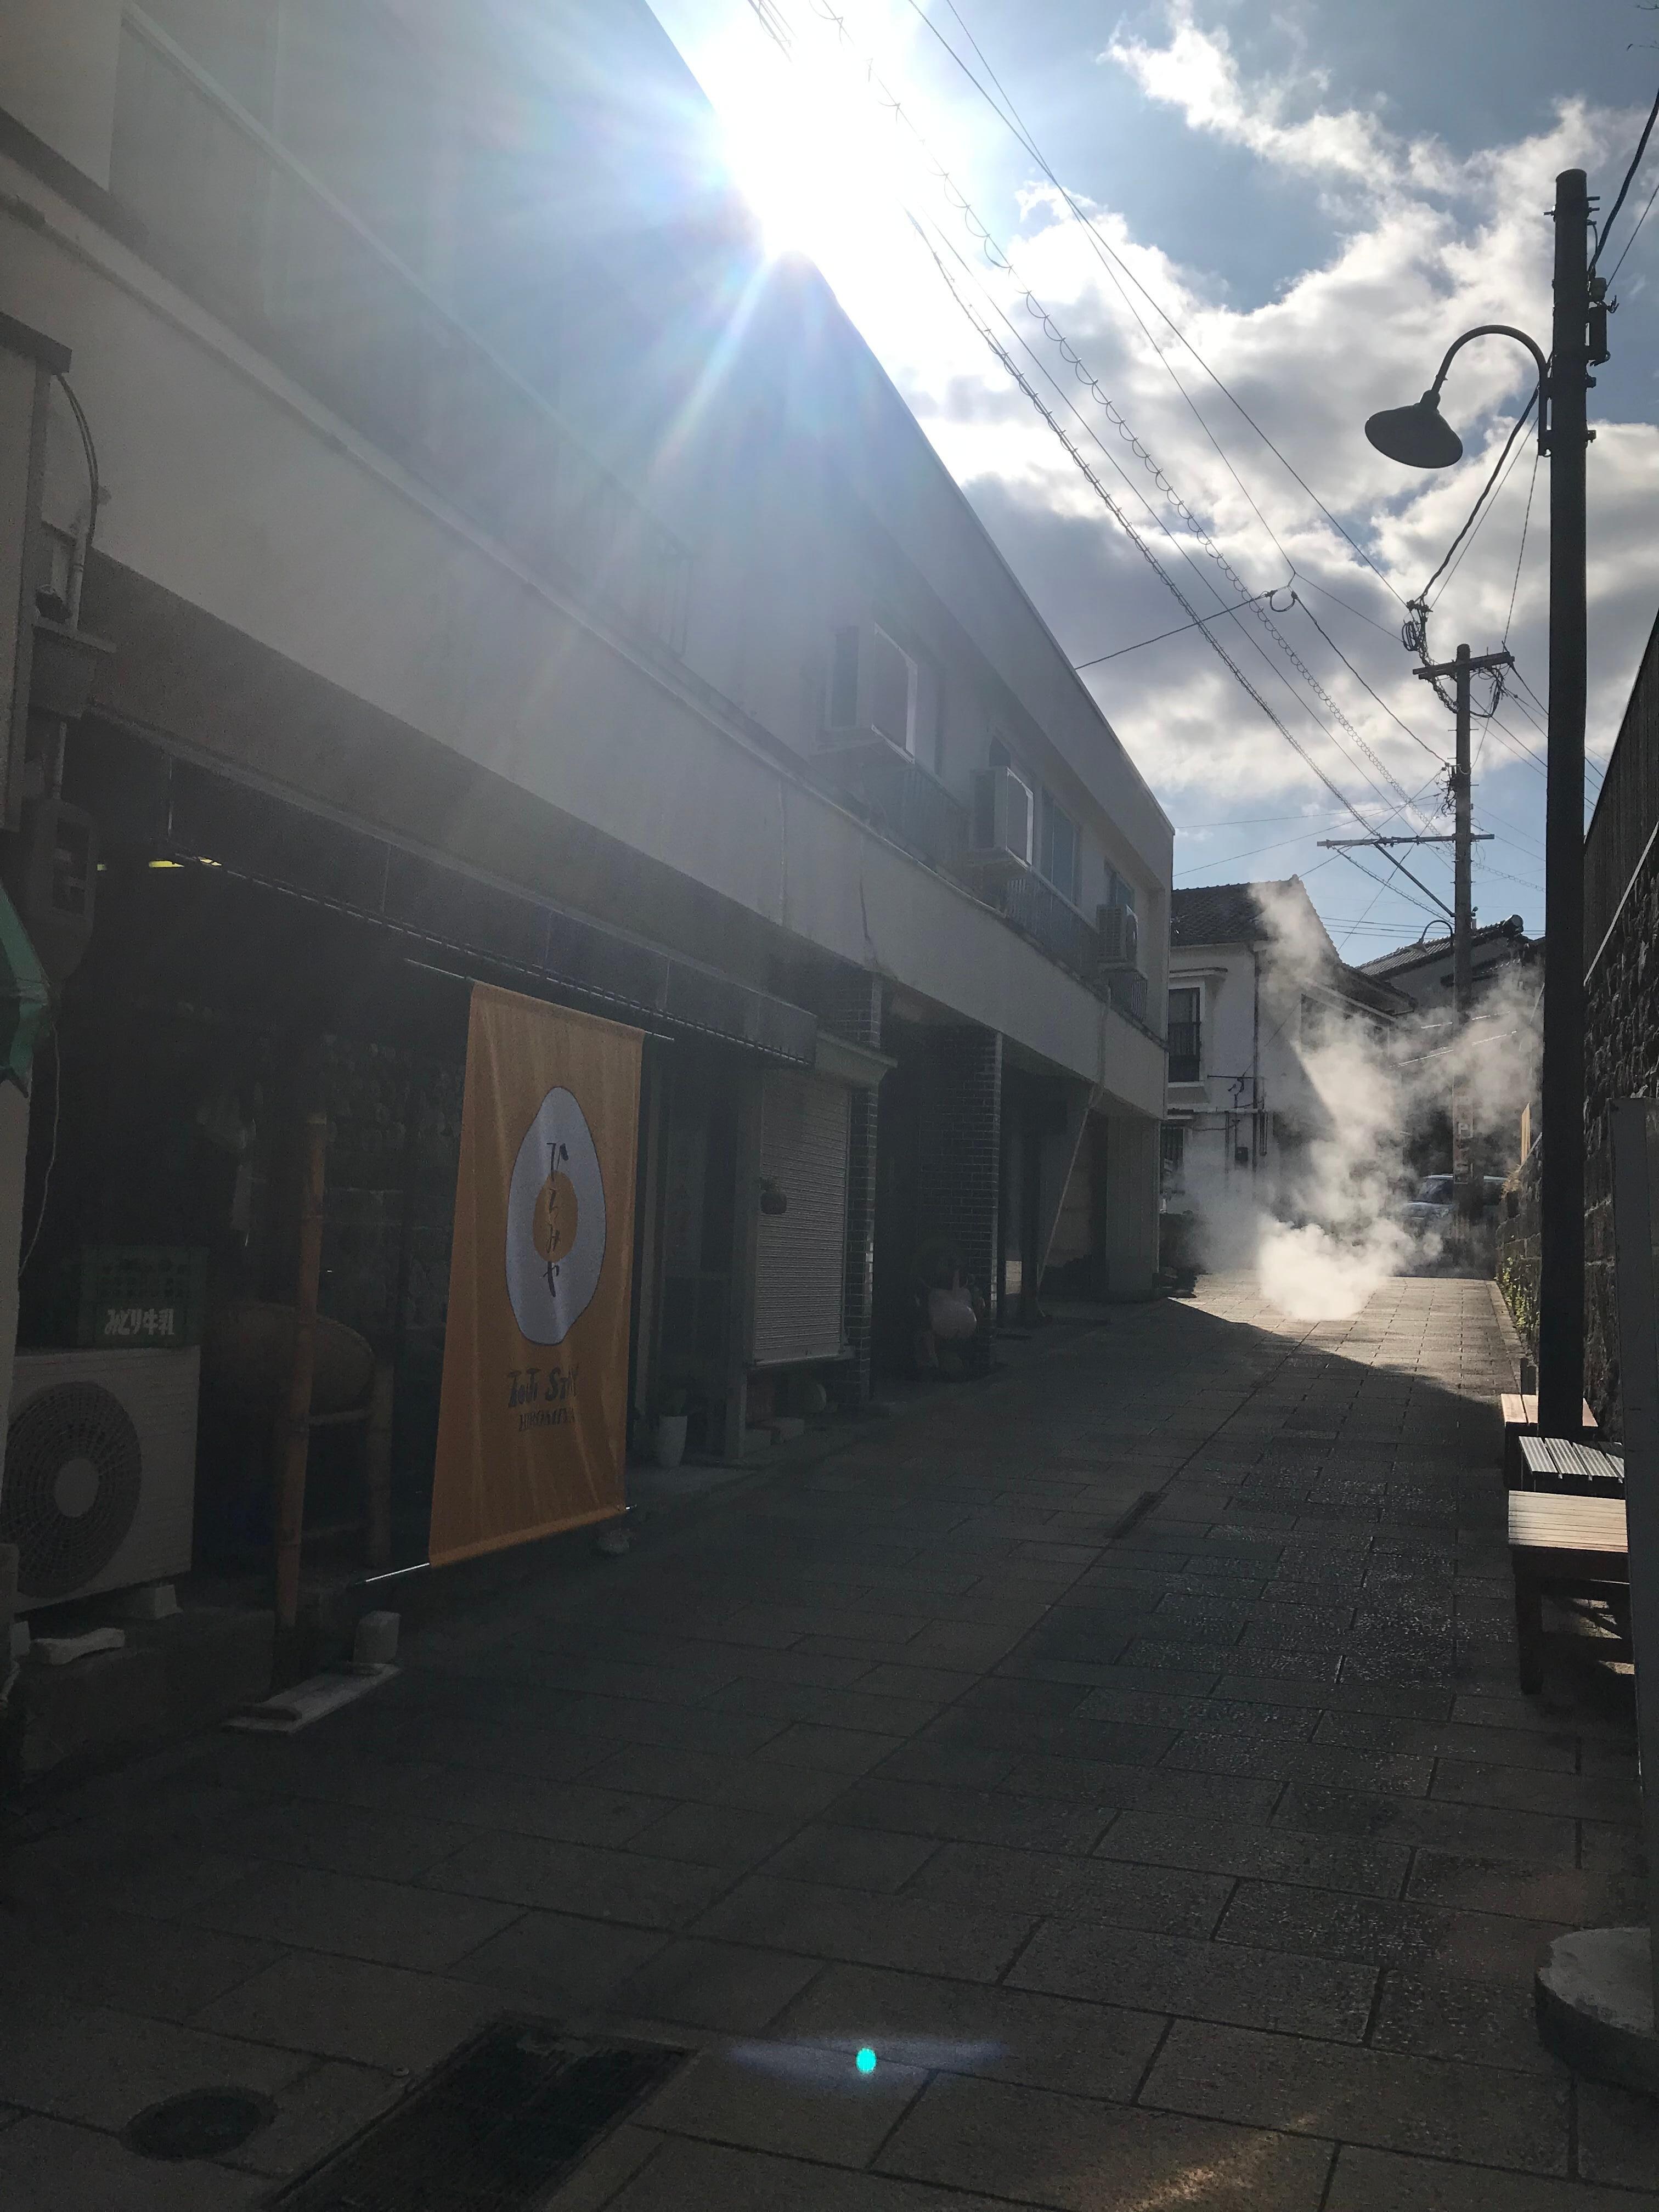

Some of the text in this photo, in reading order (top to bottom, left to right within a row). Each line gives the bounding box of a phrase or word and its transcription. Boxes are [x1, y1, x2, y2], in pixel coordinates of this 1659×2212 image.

[104, 1308, 174, 1335] みどり牛乳
